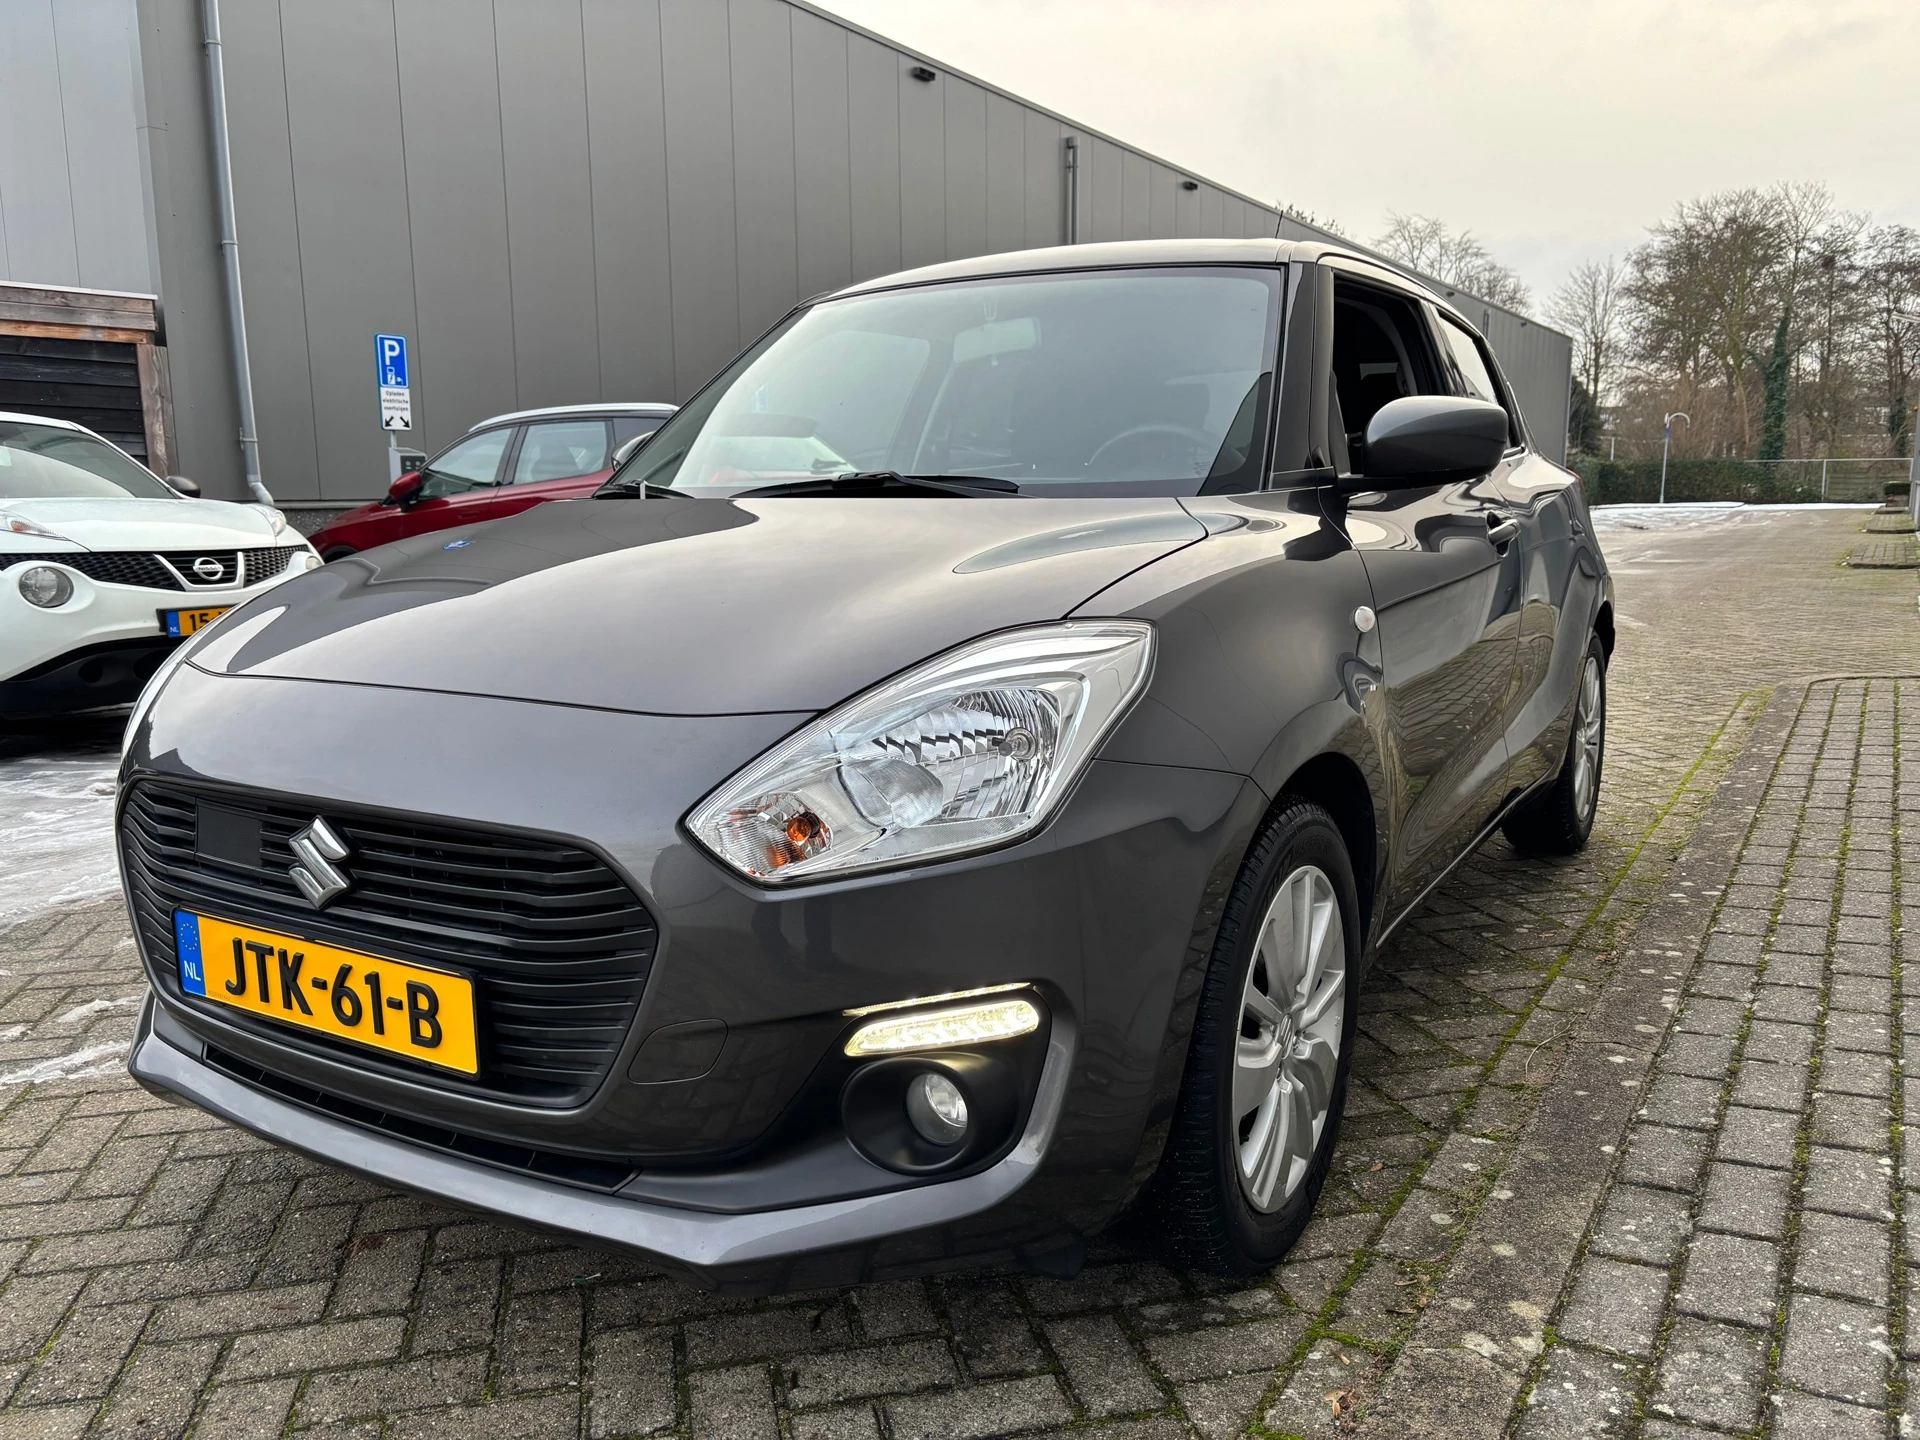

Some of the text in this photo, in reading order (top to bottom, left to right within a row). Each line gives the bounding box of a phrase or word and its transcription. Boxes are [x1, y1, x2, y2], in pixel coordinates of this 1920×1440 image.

[383, 339, 400, 366] P
[183, 960, 201, 981] NL
[225, 937, 442, 1048] JTK-61-B
